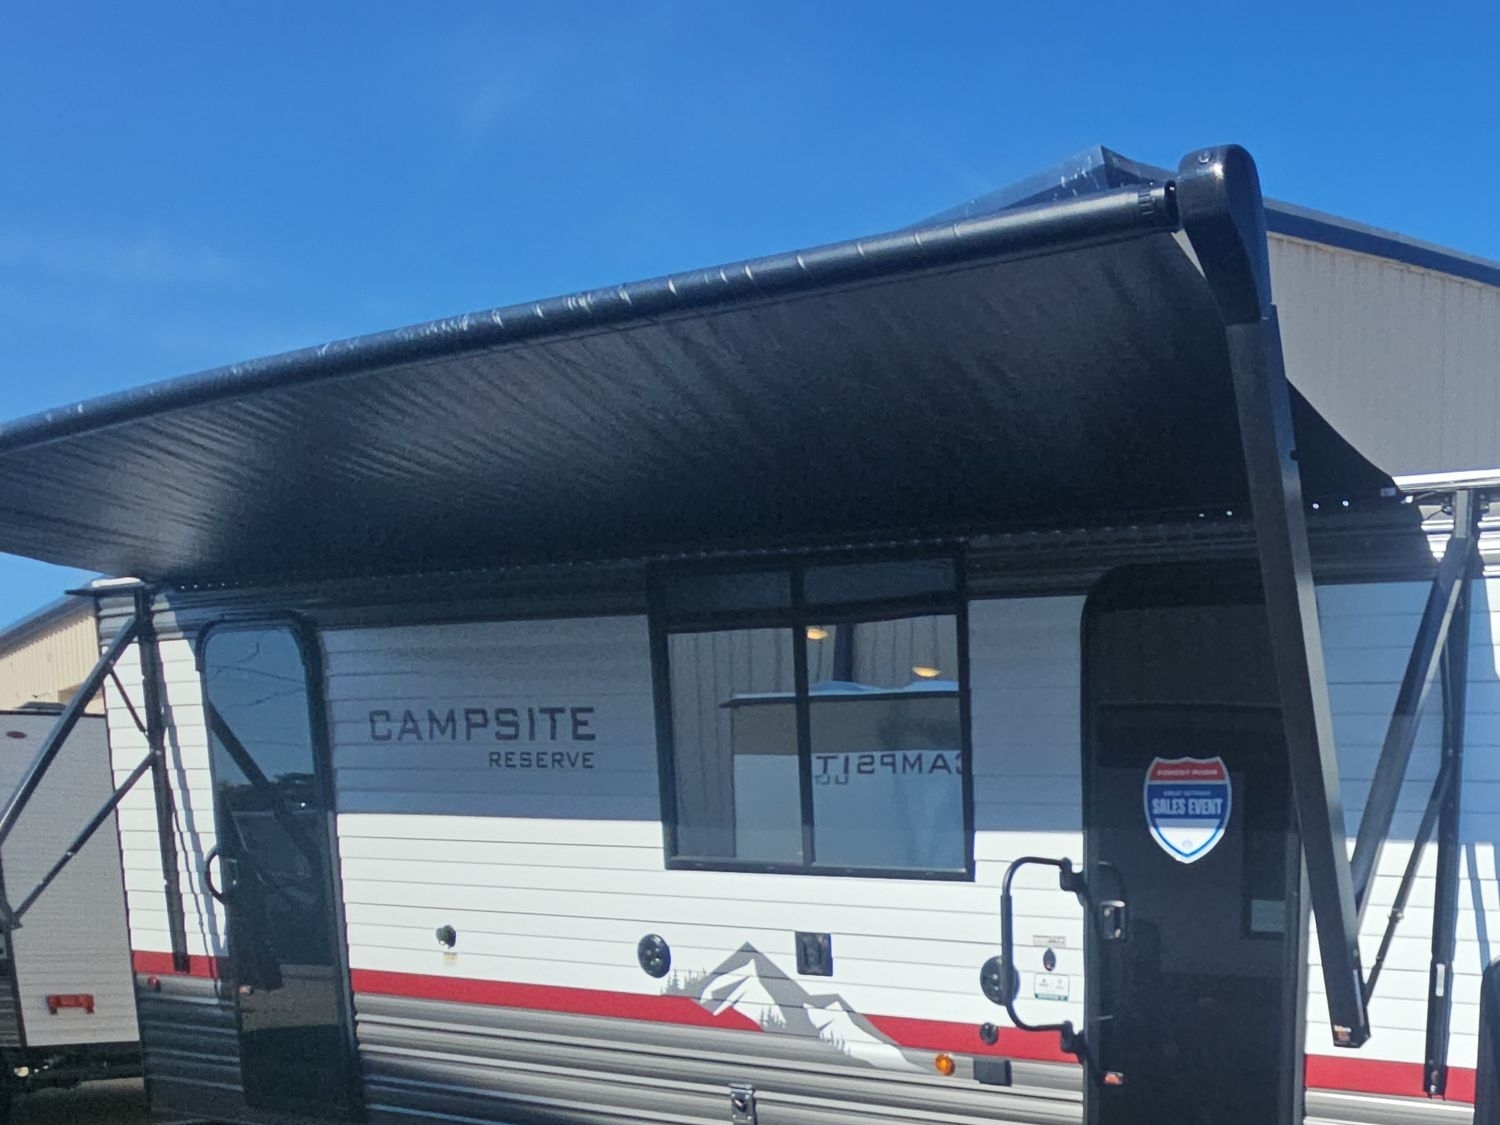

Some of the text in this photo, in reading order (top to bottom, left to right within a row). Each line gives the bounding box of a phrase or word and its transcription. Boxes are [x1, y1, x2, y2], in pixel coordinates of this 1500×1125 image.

[369, 707, 596, 741] CAMPSITE
[489, 751, 595, 769] RESERVE
[1152, 798, 1223, 816] SALES EVENT
